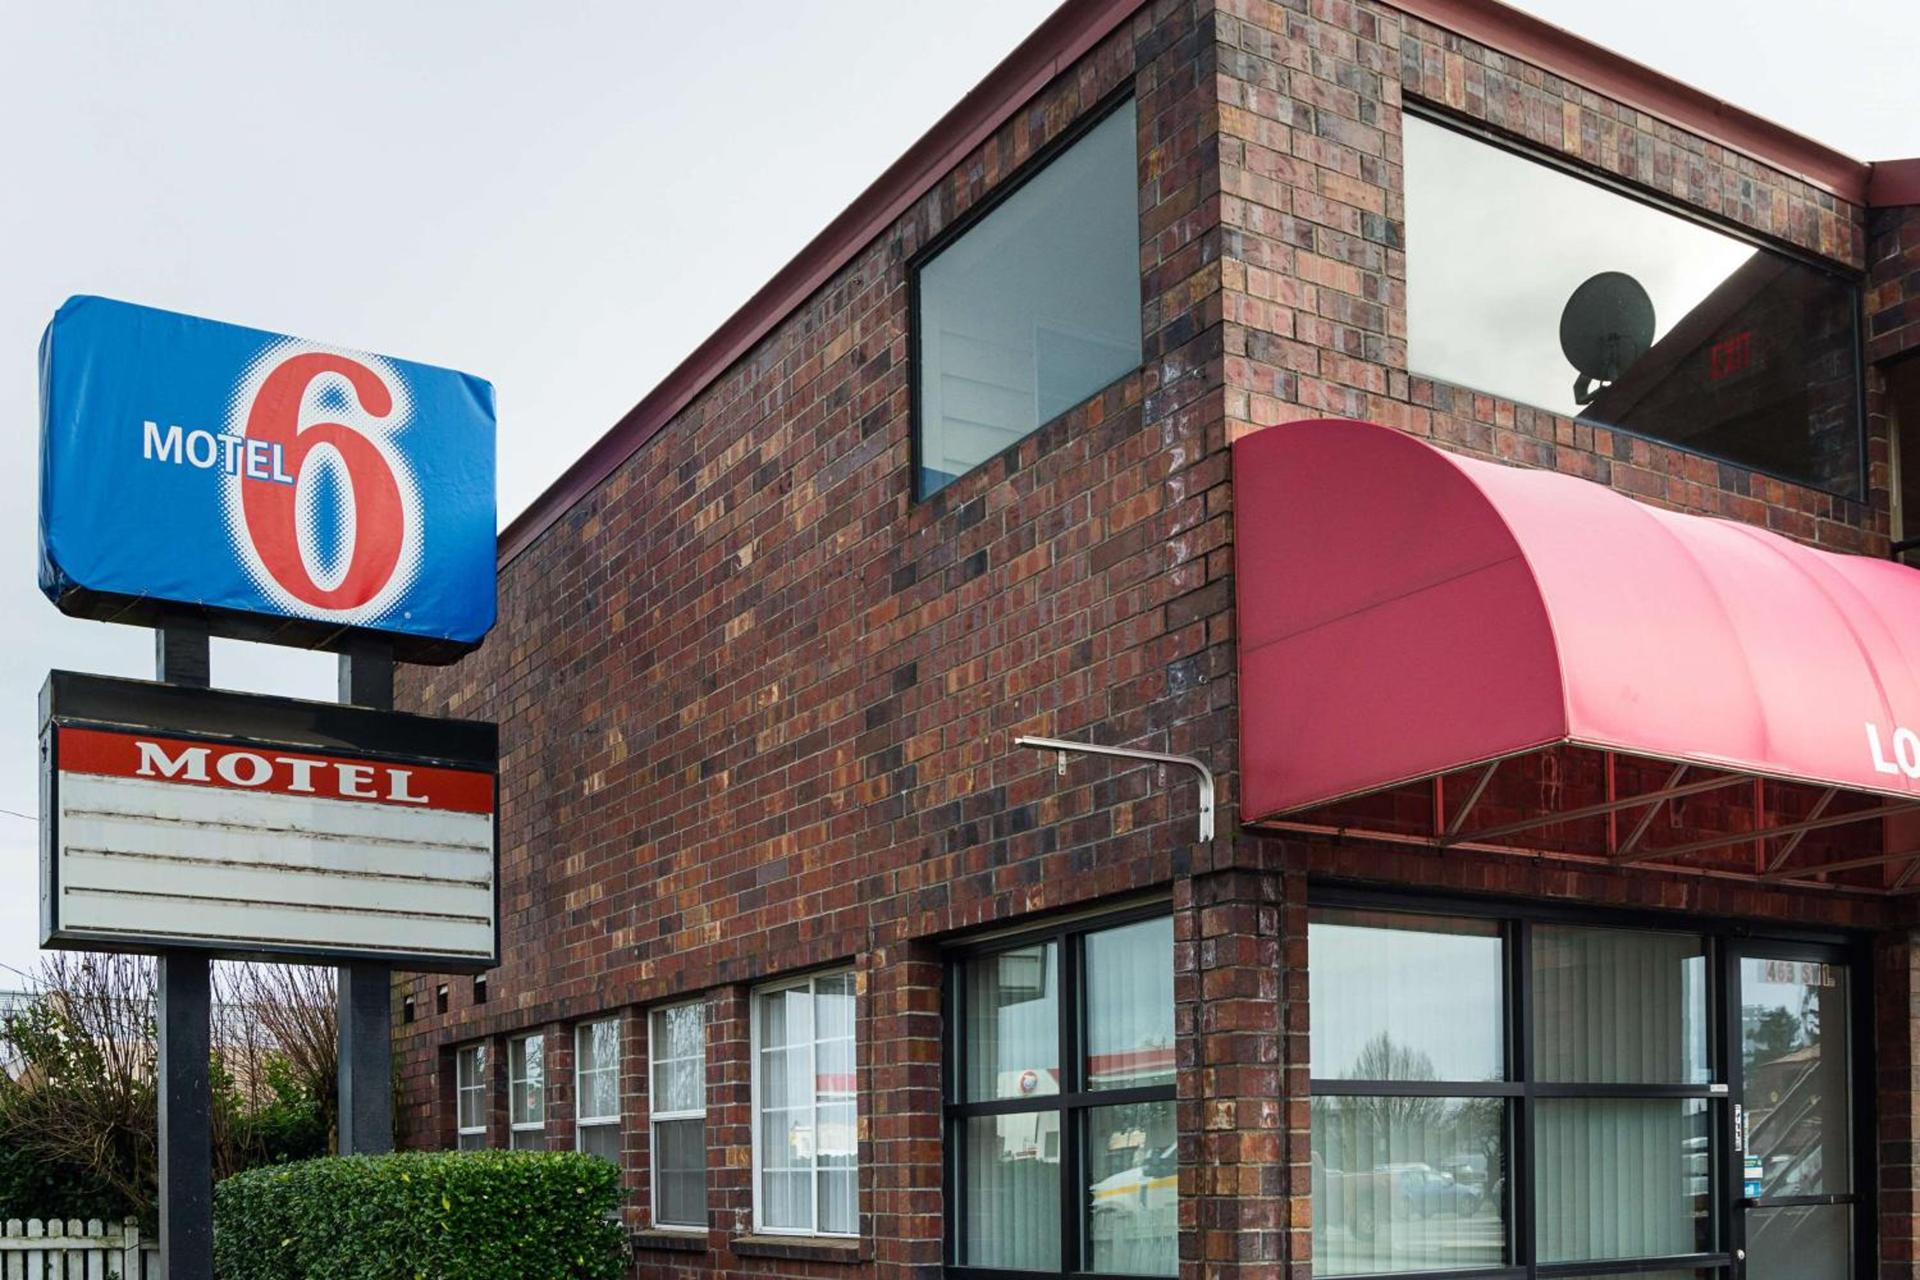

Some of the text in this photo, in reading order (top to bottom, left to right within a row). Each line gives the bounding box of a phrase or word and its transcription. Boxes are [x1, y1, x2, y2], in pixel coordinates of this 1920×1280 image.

[1709, 331, 1751, 380] EXIT
[143, 352, 405, 611] MOTEL 6
[135, 741, 430, 803] MOTEL
